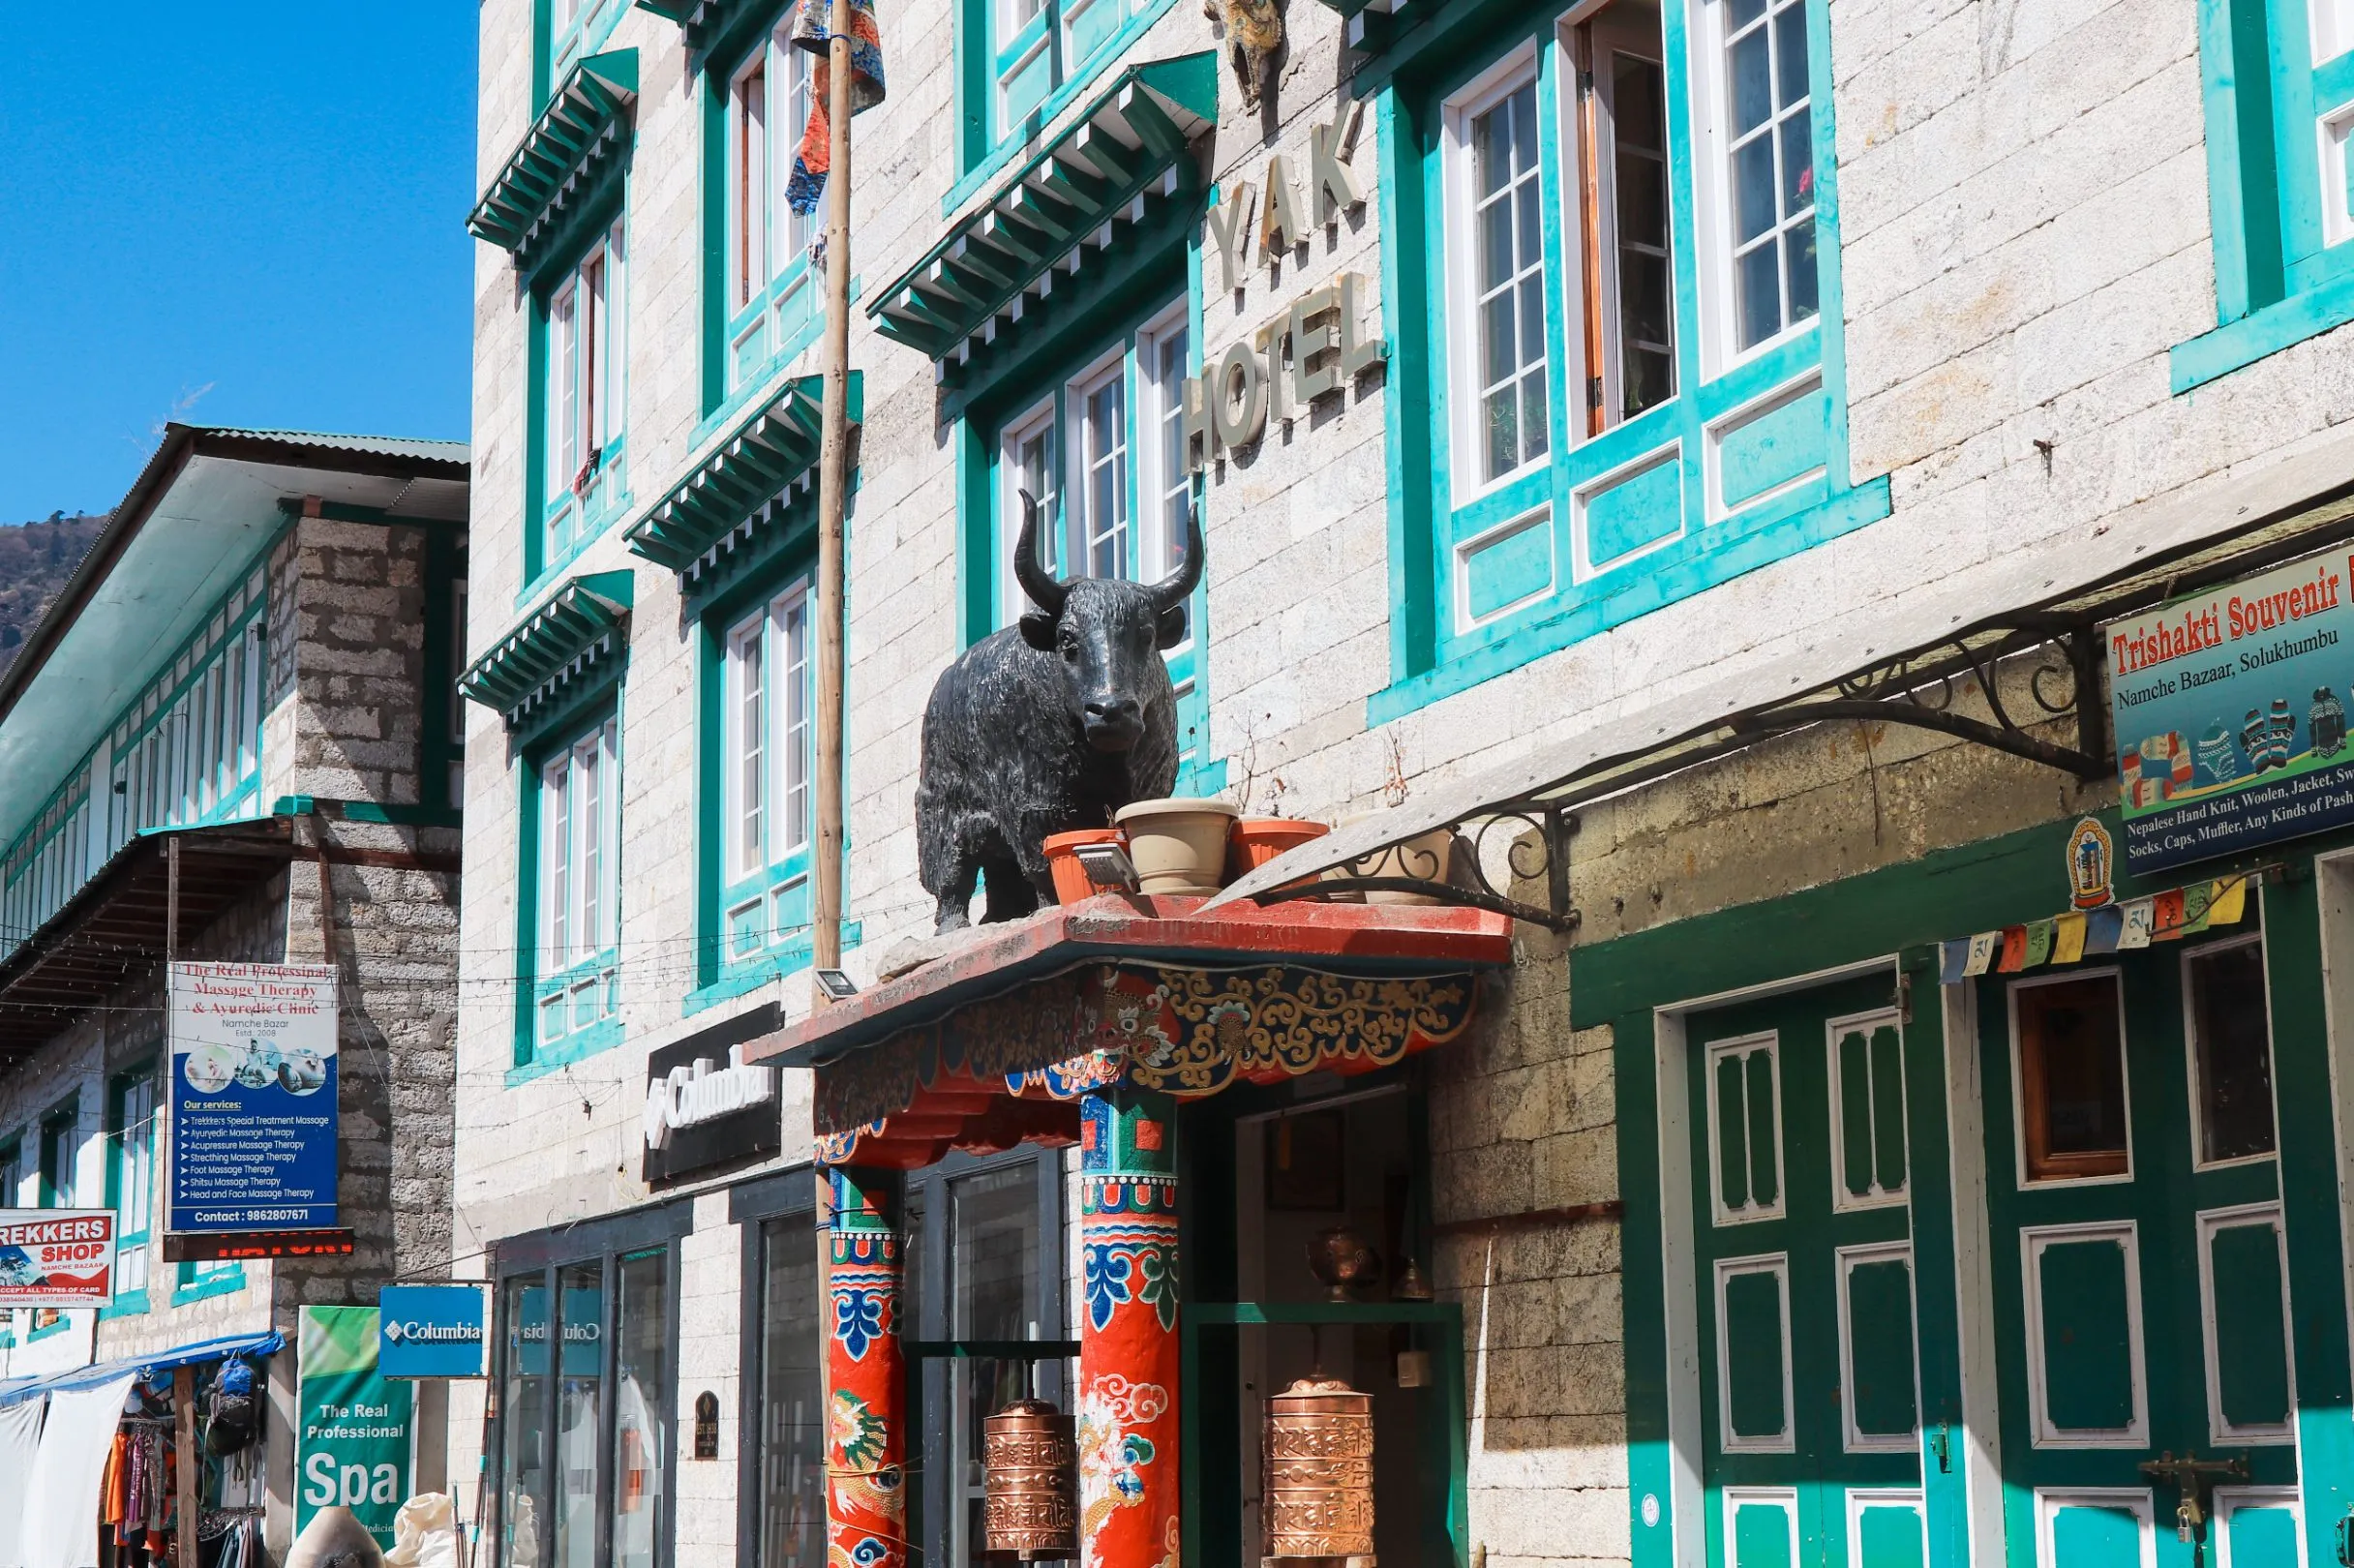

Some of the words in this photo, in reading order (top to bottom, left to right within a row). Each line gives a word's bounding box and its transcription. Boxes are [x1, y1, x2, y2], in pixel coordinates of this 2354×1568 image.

[1206, 99, 1367, 292] YAK
[1181, 272, 1388, 475] HOTEL
[2112, 602, 2222, 676] Trishakti
[2227, 565, 2339, 641] Souvenir
[2118, 679, 2177, 709] Namche
[2180, 663, 2236, 690] Bazaar,
[2240, 629, 2339, 672] Solukhumbu
[2128, 816, 2174, 838] Nepalese
[2177, 804, 2207, 824] Hand
[2210, 798, 2240, 815] Knit,
[2242, 786, 2289, 807] Woolen,
[2291, 773, 2334, 795] Jacket,
[2129, 843, 2162, 859] Socks,
[2164, 833, 2196, 850] Caps,
[2198, 821, 2243, 841] Muffler,
[2245, 814, 2269, 829] Any
[2272, 801, 2308, 823] Kinds
[2309, 797, 2322, 813] of
[2325, 790, 2354, 810] Pash
[185, 964, 211, 977] The
[216, 964, 247, 977] Real
[195, 982, 254, 997] Massage
[258, 983, 317, 999] Therapy
[193, 1002, 205, 1013] &
[277, 1002, 318, 1014] Clinic
[222, 1019, 261, 1028] Namche
[264, 1019, 288, 1028] Bazar
[257, 1029, 276, 1038] 2008
[184, 1101, 201, 1109] Our
[203, 1100, 242, 1109] services:
[226, 1116, 255, 1127] Special
[256, 1116, 294, 1125] Treatment
[295, 1116, 329, 1127] Massage
[229, 1129, 263, 1139] Massage
[265, 1128, 295, 1138] Therapy
[191, 1141, 237, 1152] Acupressure
[239, 1141, 273, 1152] Massage
[274, 1140, 305, 1151] Therapy
[230, 1153, 264, 1163] Massage
[266, 1152, 296, 1162] Therapy
[190, 1165, 206, 1174] Foot
[208, 1165, 243, 1176] Massage
[244, 1164, 274, 1175] Therapy
[190, 1177, 213, 1187] Shitsu
[214, 1177, 249, 1188] Massage
[250, 1177, 281, 1188] Therapy
[190, 1190, 210, 1199] Head
[211, 1190, 226, 1199] and
[228, 1190, 247, 1198] Face
[248, 1189, 283, 1199] Massage
[284, 1189, 314, 1199] Therapy
[195, 1212, 240, 1222] Contact
[247, 1210, 309, 1221] 9862807671
[0, 1220, 105, 1246] REKKERS
[41, 1243, 105, 1262] SHOP
[403, 1320, 481, 1341] Columbia
[319, 1404, 349, 1419] The
[354, 1403, 388, 1418] Real
[307, 1424, 404, 1439] Professional
[304, 1452, 399, 1507] Spa
